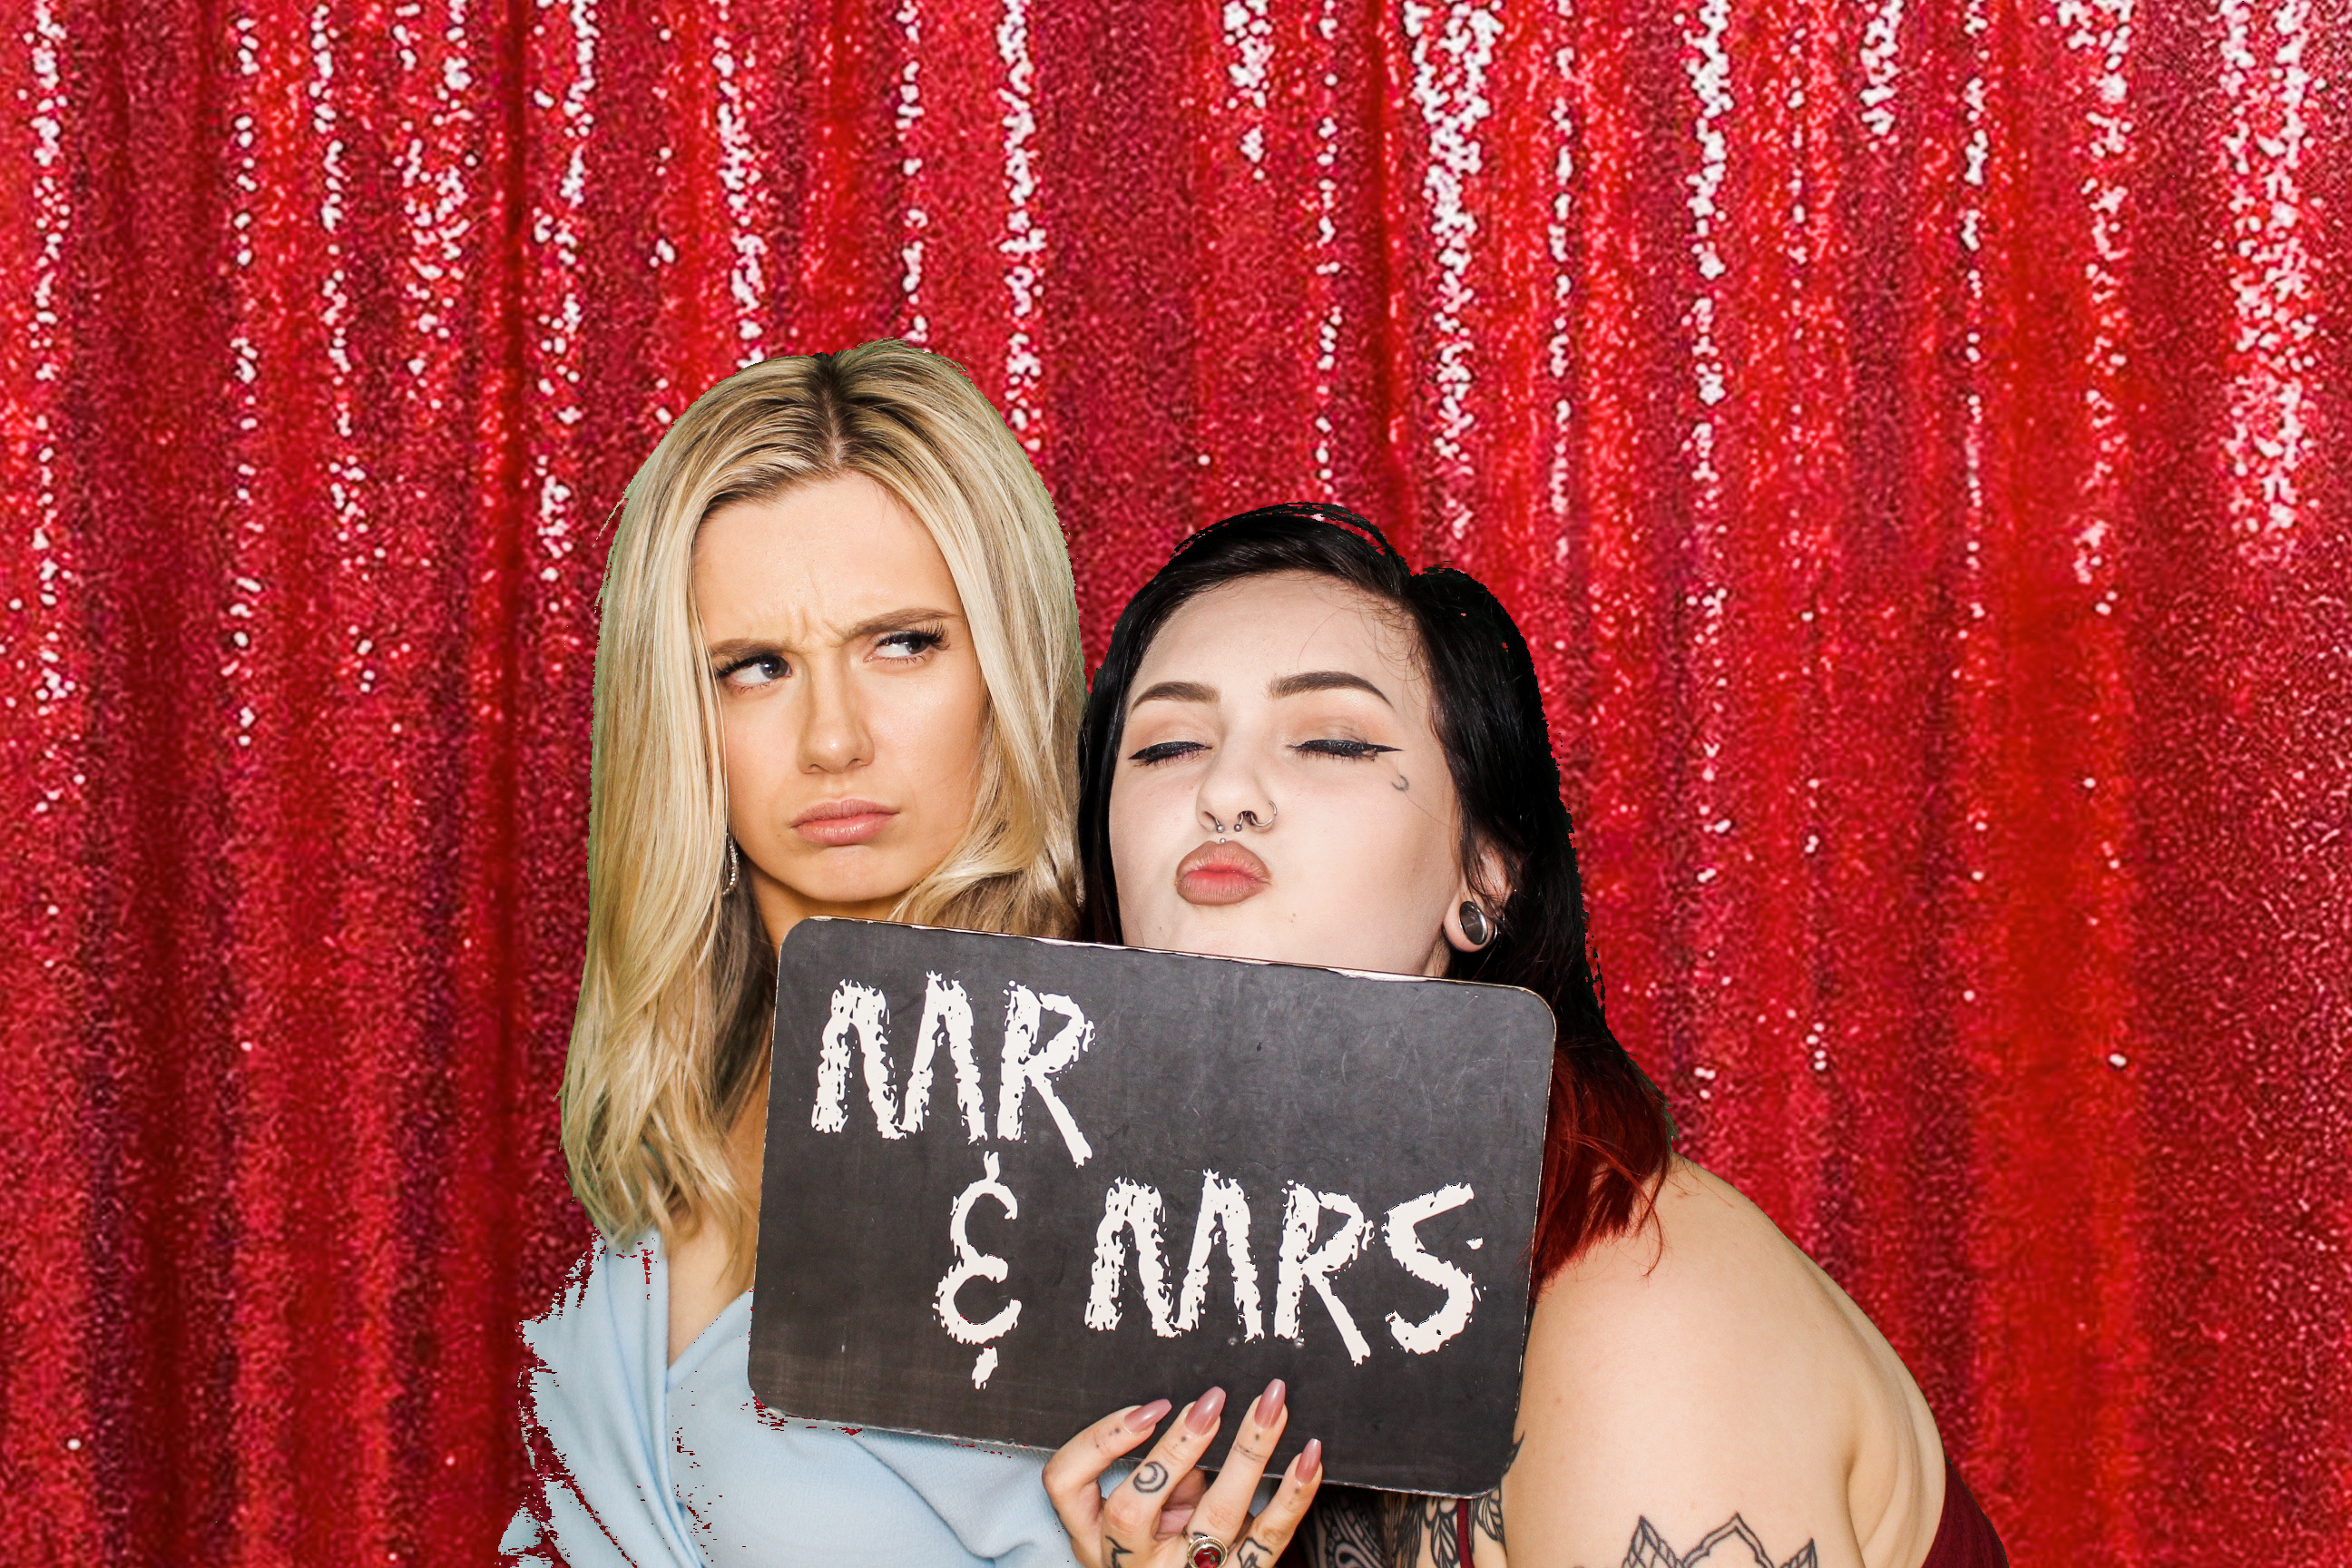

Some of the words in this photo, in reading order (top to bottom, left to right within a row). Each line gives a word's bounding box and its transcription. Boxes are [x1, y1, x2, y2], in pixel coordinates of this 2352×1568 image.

[810, 970, 1095, 1168] MR
[932, 1151, 1022, 1389] &
[1084, 1168, 1484, 1367] MRS
